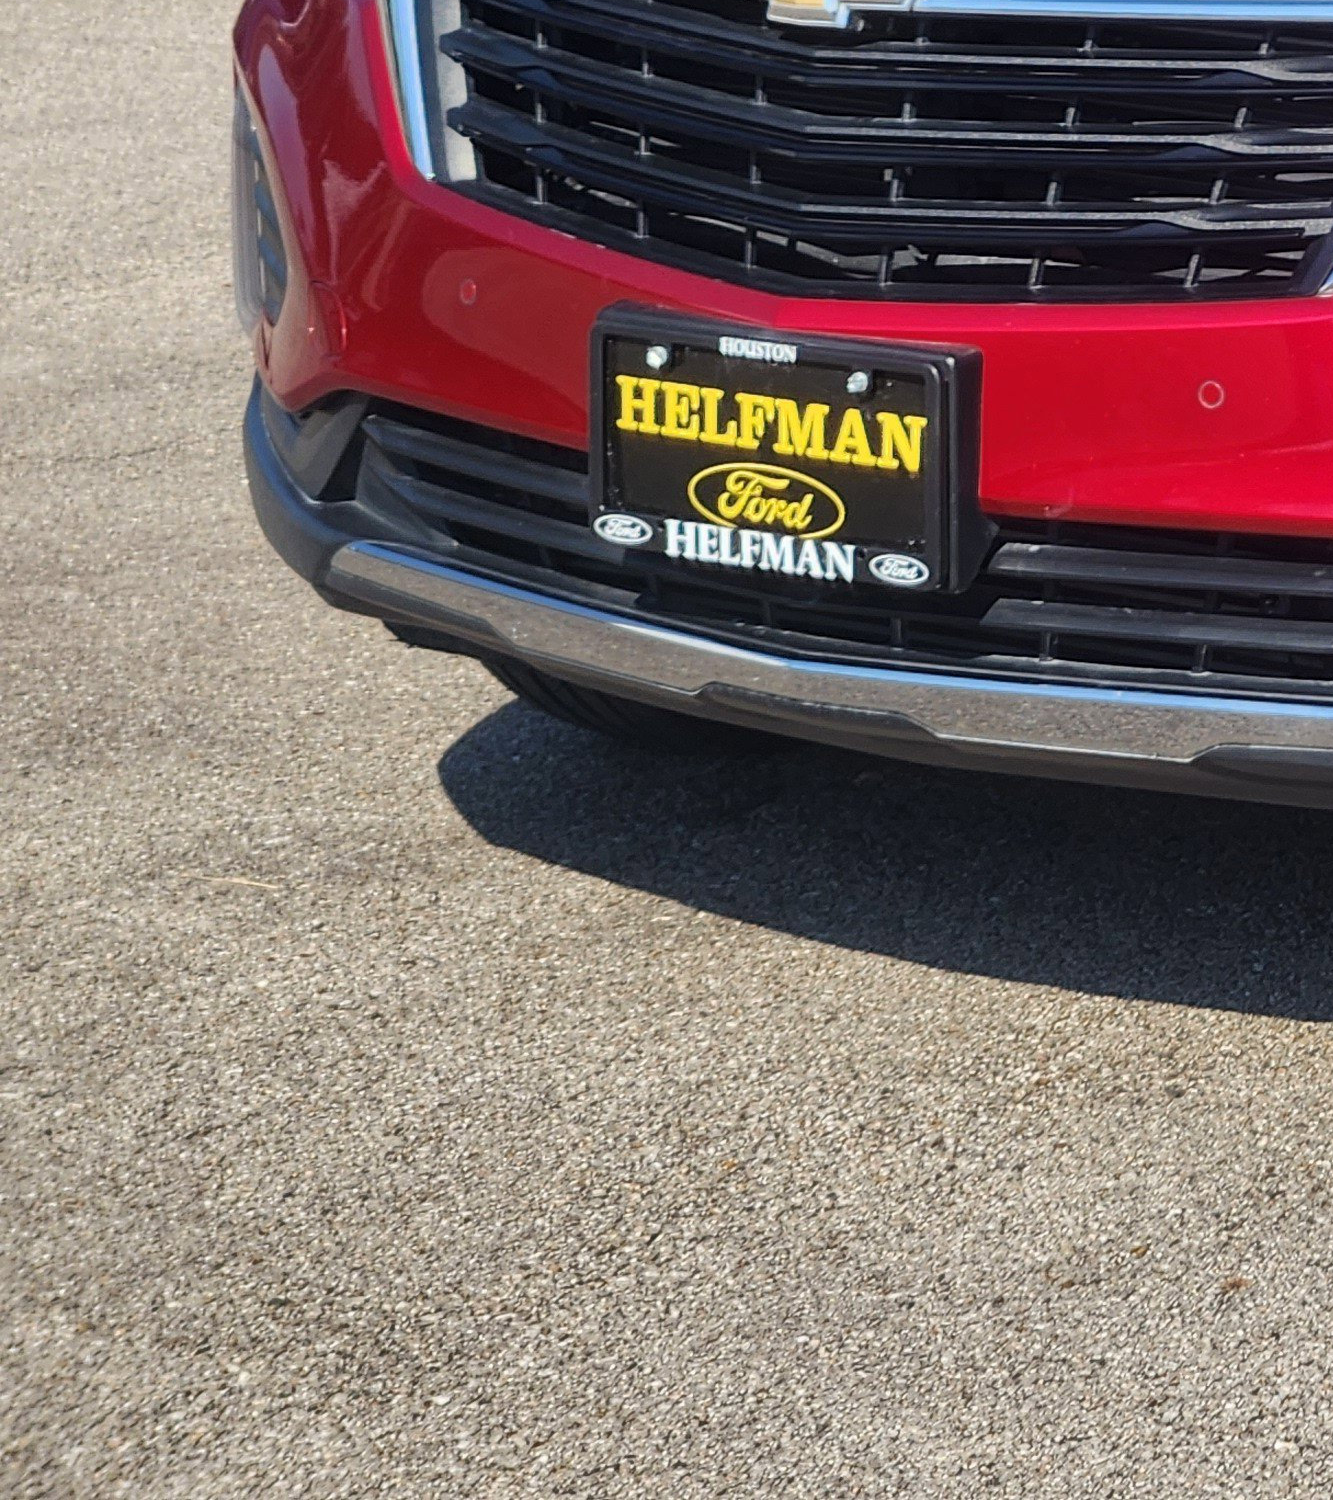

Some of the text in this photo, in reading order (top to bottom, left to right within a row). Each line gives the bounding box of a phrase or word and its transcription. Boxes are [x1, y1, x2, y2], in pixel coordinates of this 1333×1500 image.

[719, 336, 797, 363] HOUSTON
[615, 374, 928, 473] HELFMAN
[717, 470, 813, 530] Ford
[664, 518, 856, 583] HELFMAN
